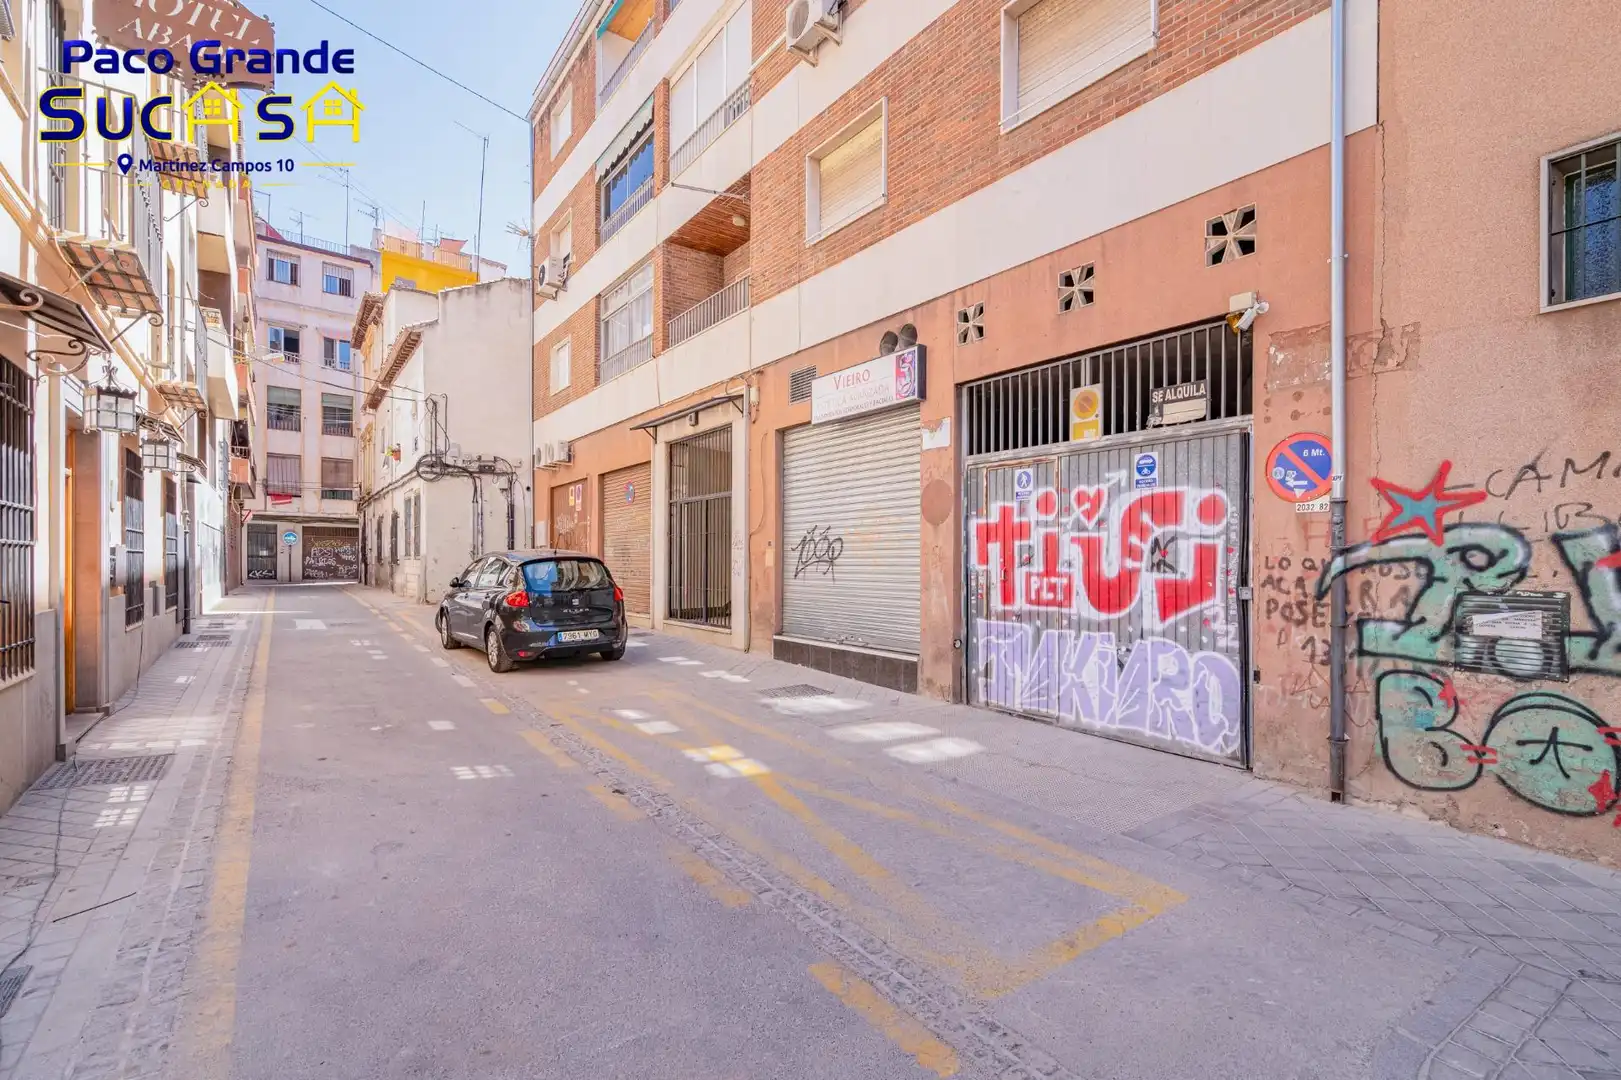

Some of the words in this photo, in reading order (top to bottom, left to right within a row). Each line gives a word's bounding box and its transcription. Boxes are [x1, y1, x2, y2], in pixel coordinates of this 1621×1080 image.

[133, 0, 260, 46] OTEL
[1152, 389, 1164, 403] SE
[1165, 382, 1206, 401] ALQUILA
[1303, 449, 1309, 457] 6
[1297, 503, 1315, 512] 2032
[1319, 502, 1329, 511] 82
